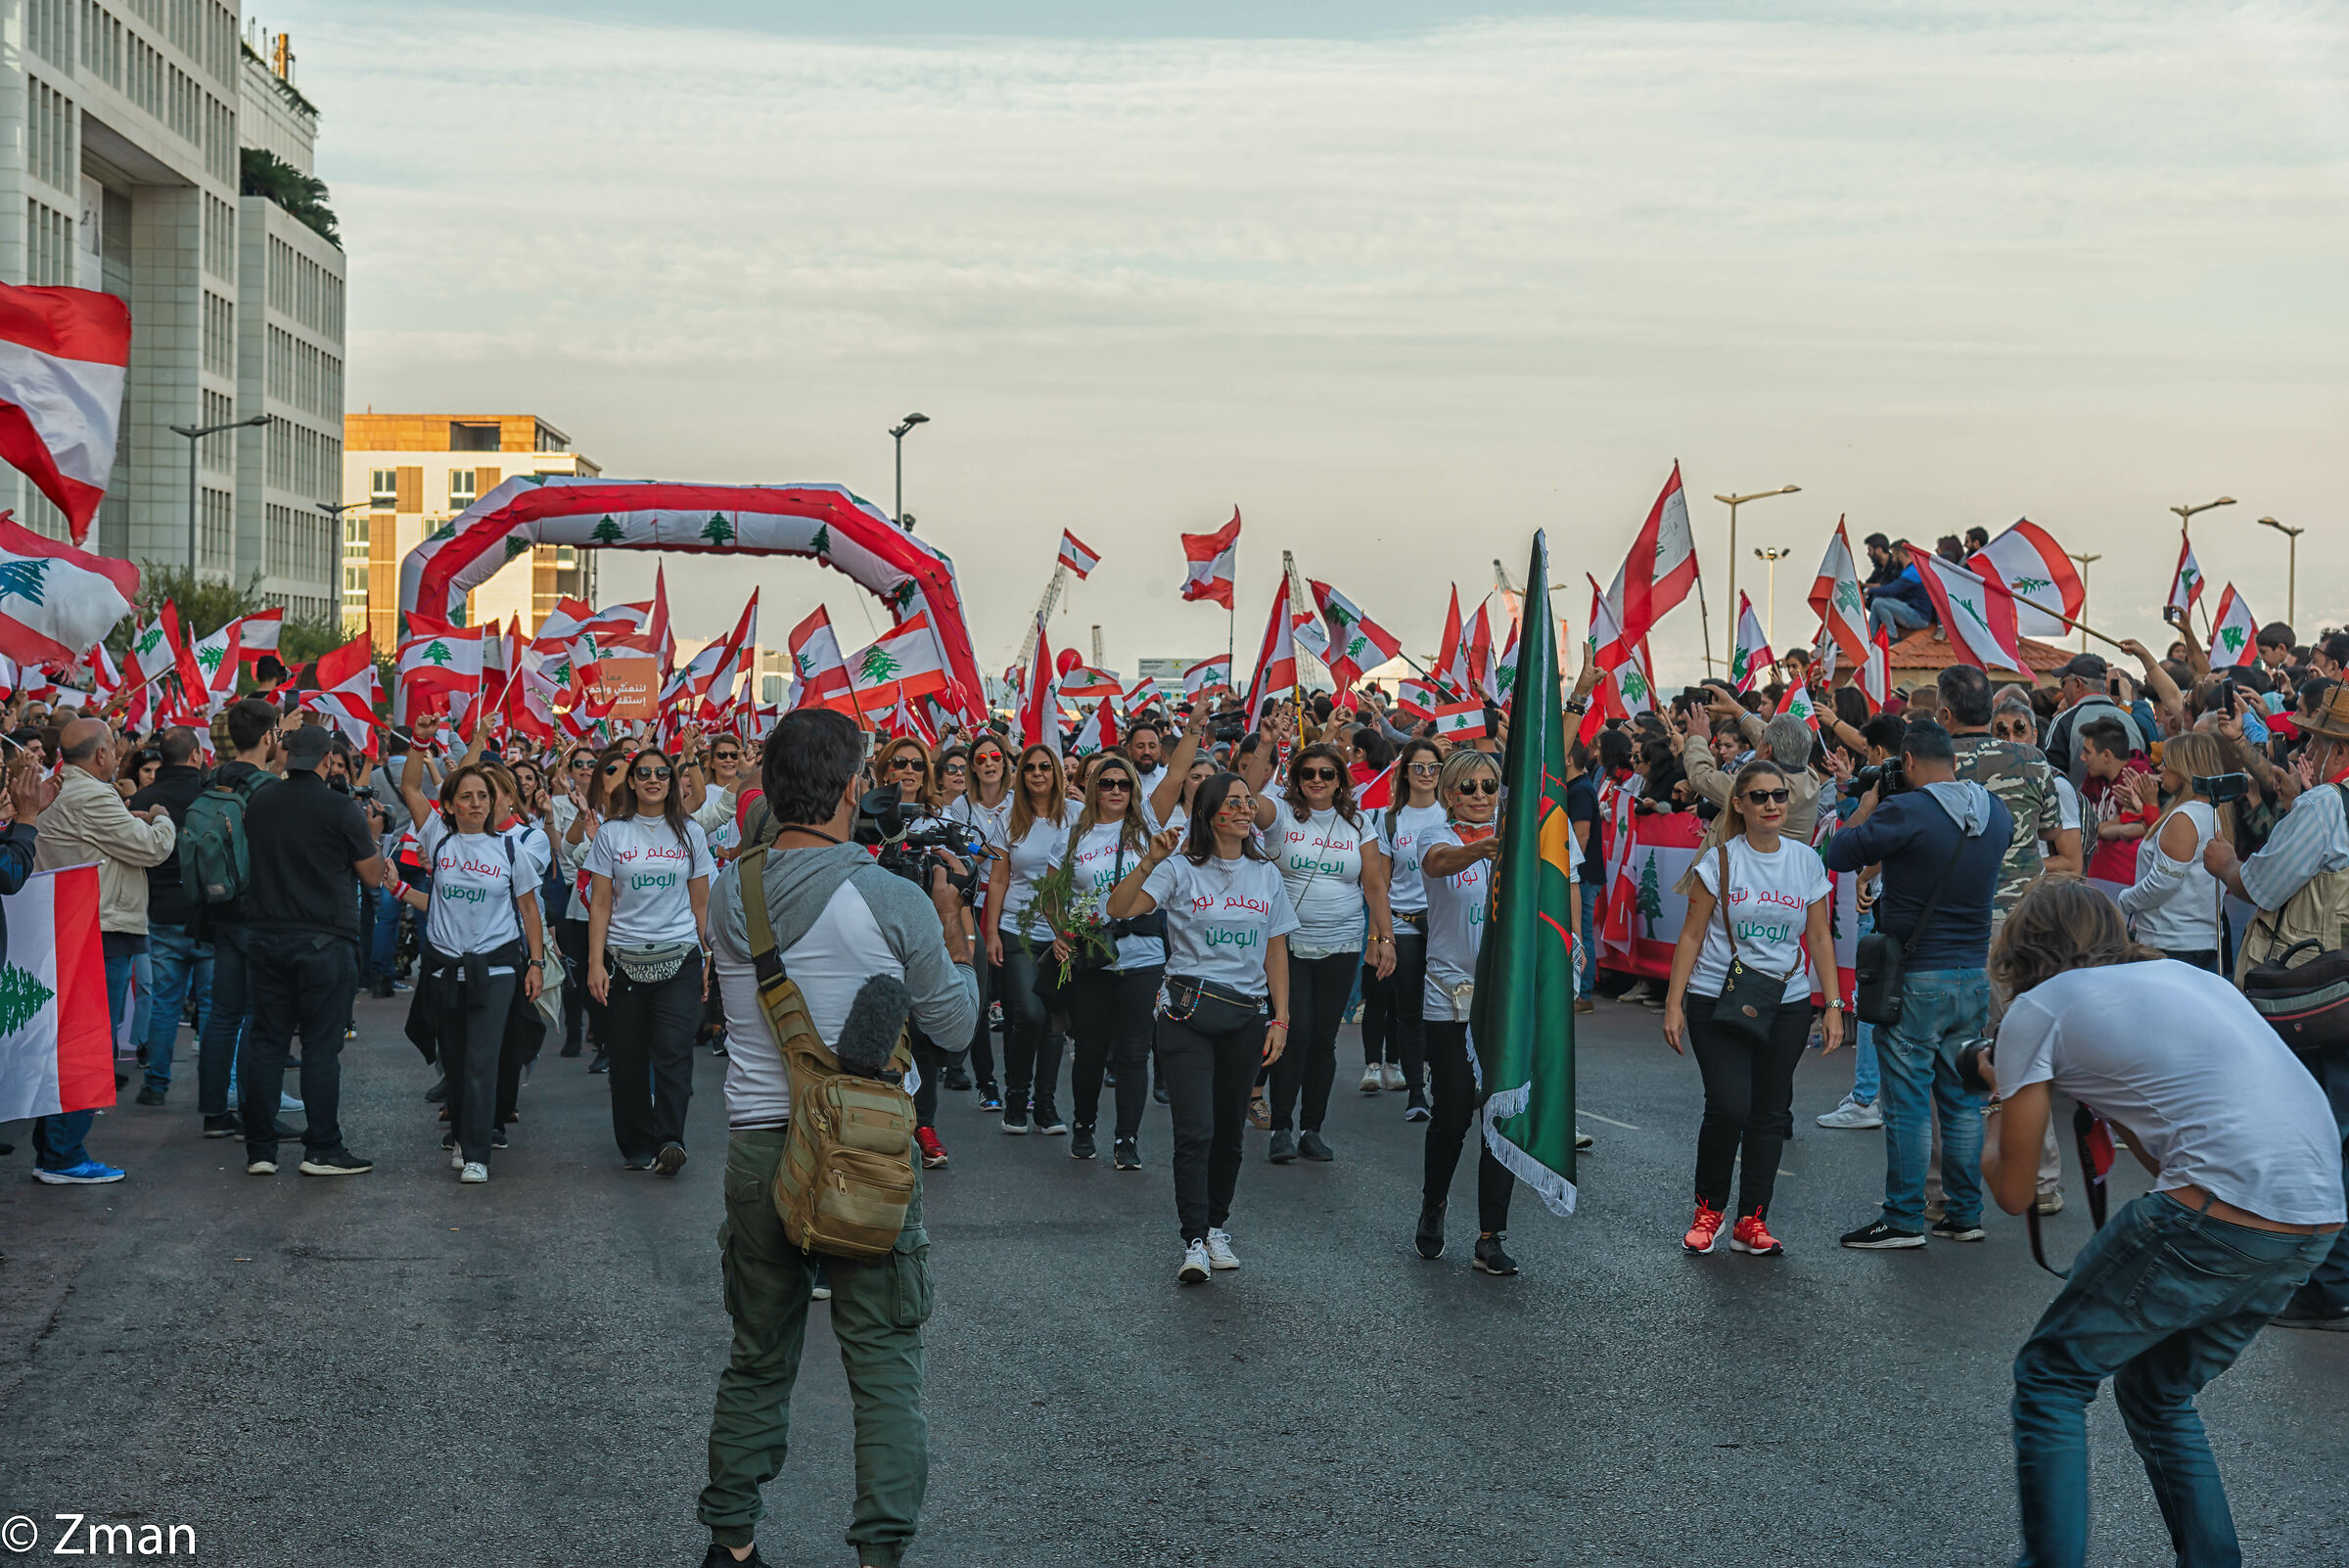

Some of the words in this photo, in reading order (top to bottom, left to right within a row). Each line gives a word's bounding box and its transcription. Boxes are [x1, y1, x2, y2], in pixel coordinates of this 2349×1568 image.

[1284, 830, 1306, 845] نور
[1396, 832, 1412, 851] نور
[619, 846, 638, 864] نور
[1080, 849, 1098, 865] نور
[1289, 853, 1345, 874] الوطن
[631, 872, 676, 891] الوطن
[1456, 867, 1479, 889] نور
[442, 883, 486, 903] الوطن
[1191, 894, 1214, 913] نور
[1205, 926, 1258, 949] الوطن
[1737, 920, 1790, 944] الوطن
